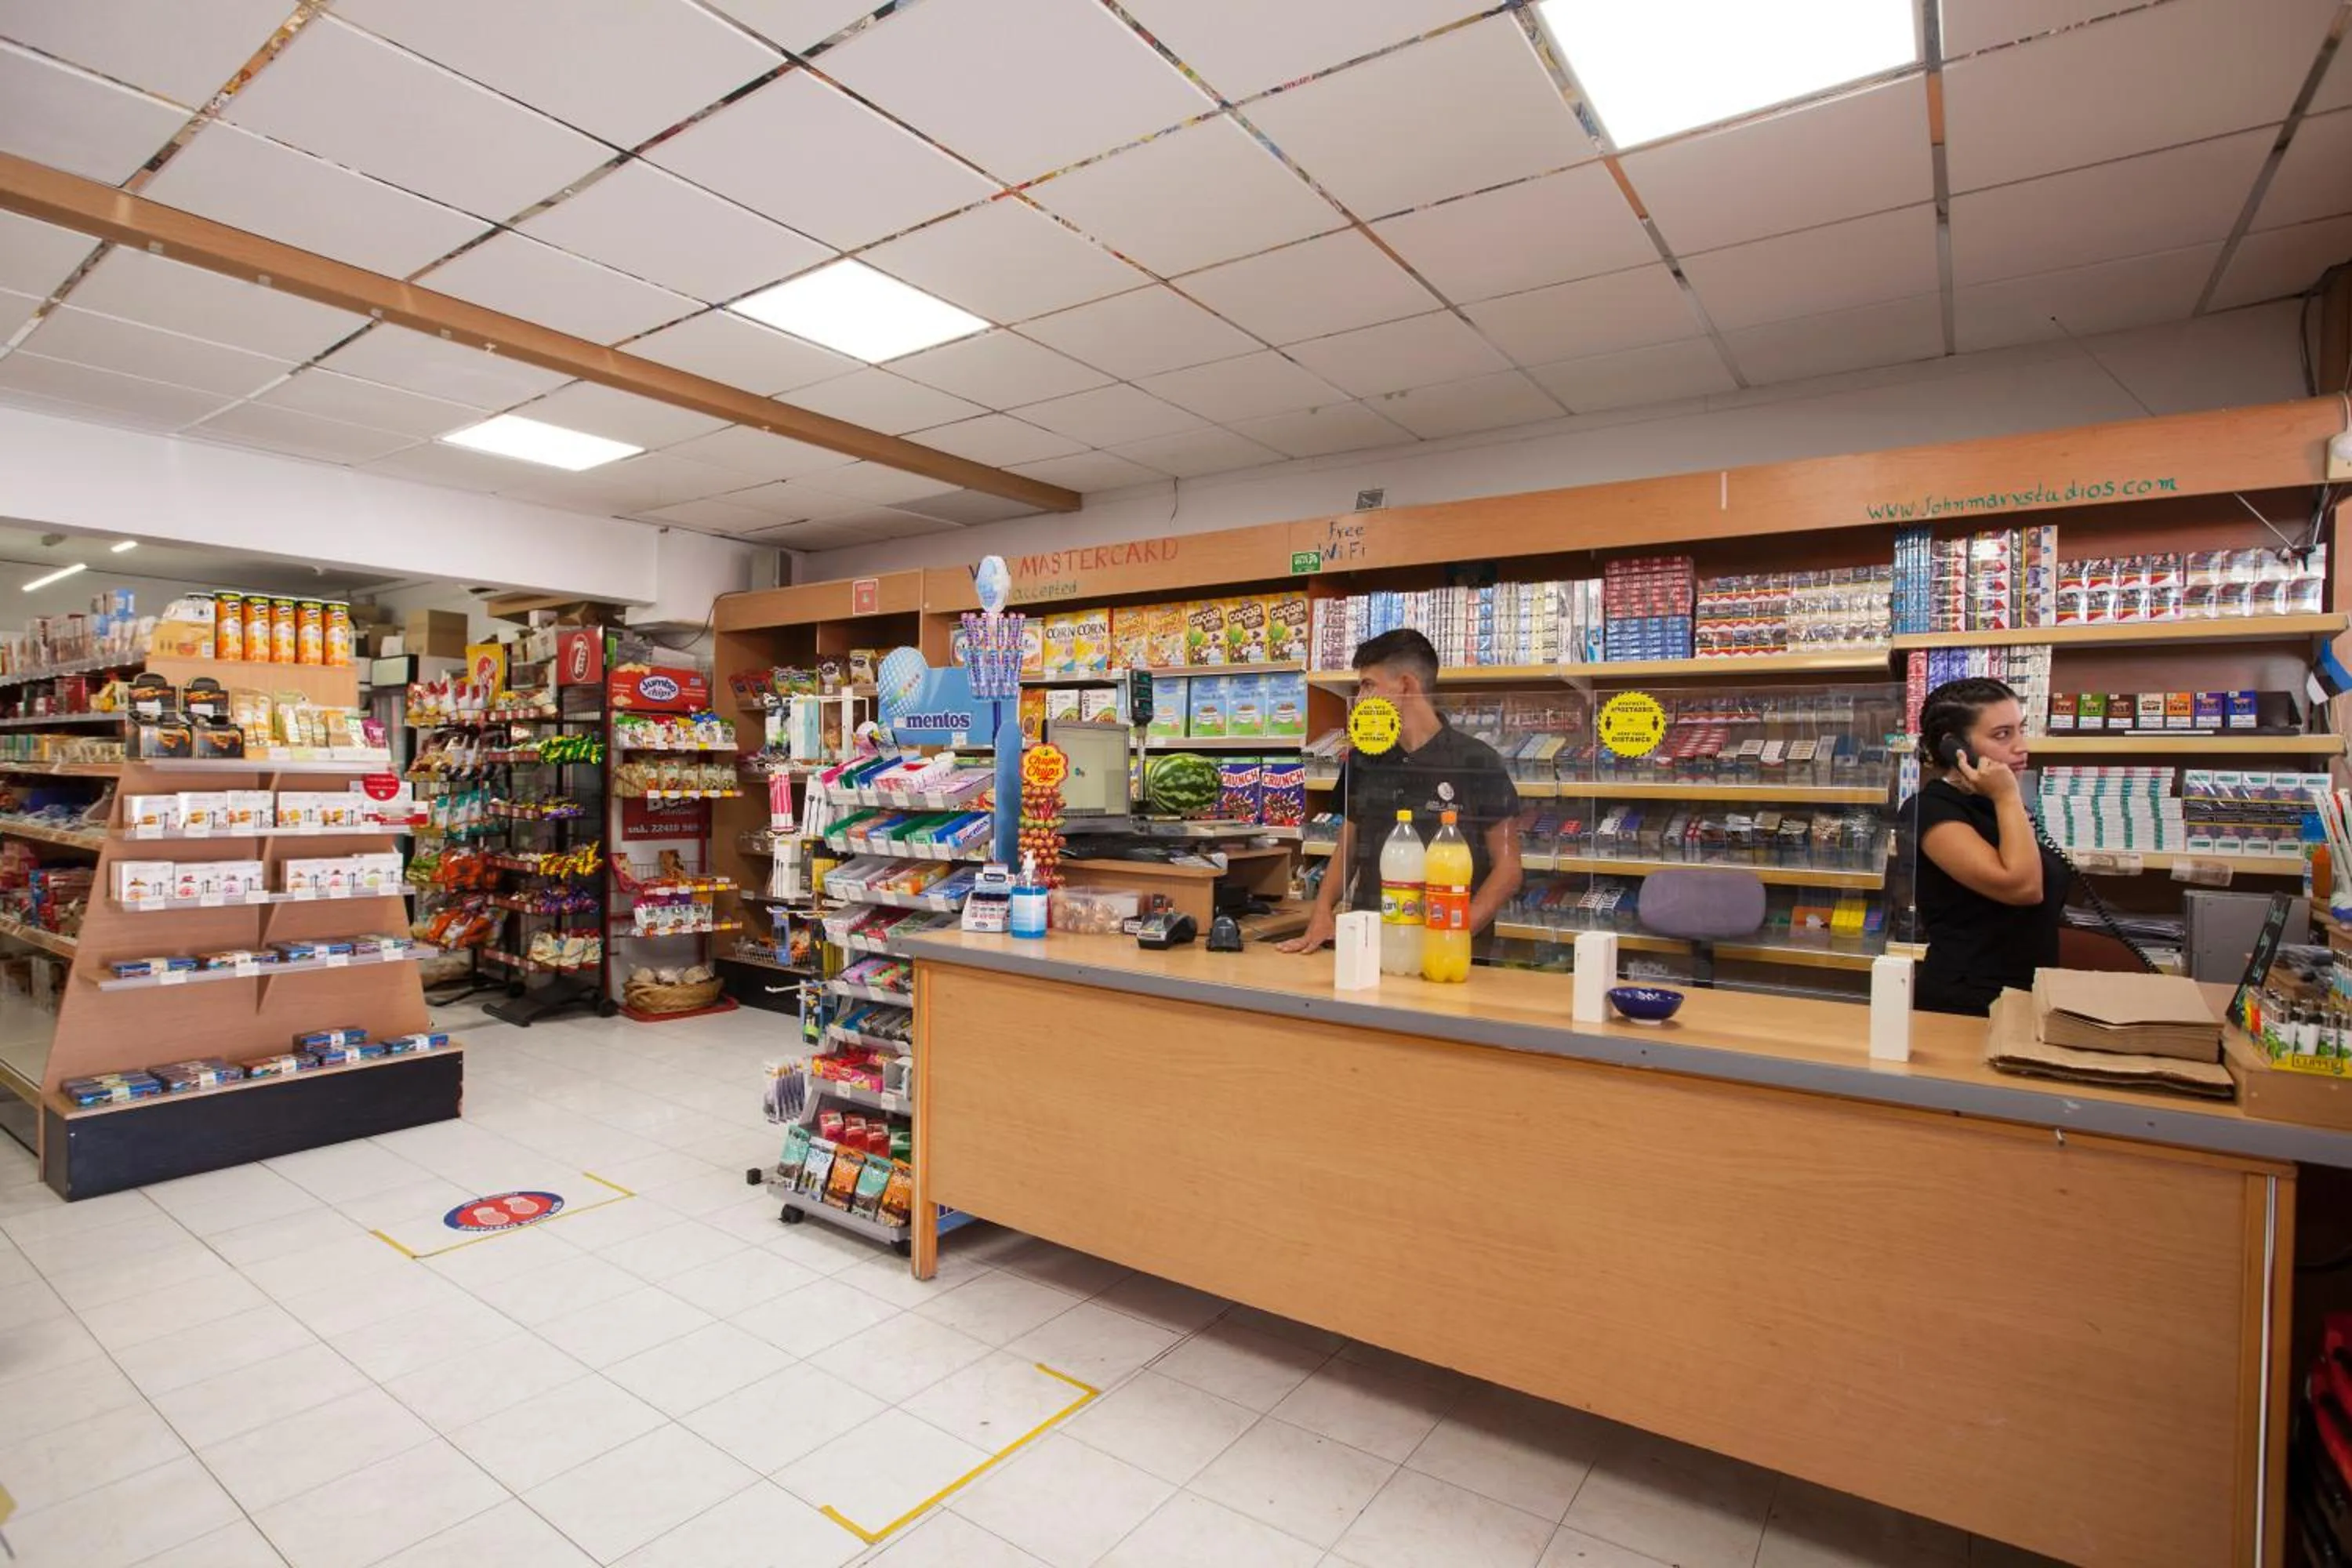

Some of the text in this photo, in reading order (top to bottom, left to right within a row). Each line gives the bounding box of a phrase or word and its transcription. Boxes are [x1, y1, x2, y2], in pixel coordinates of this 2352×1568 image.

[1328, 521, 1367, 540] Free
[1019, 537, 1178, 578] MASTERCARD
[1012, 580, 1077, 601] accepted
[1046, 626, 1076, 639] CORN
[1077, 622, 1106, 636] CORN
[641, 678, 677, 693] Jumbo
[906, 711, 971, 729] mentos
[1221, 768, 1258, 787] CRUNCH
[1263, 768, 1305, 788] CRUNCH
